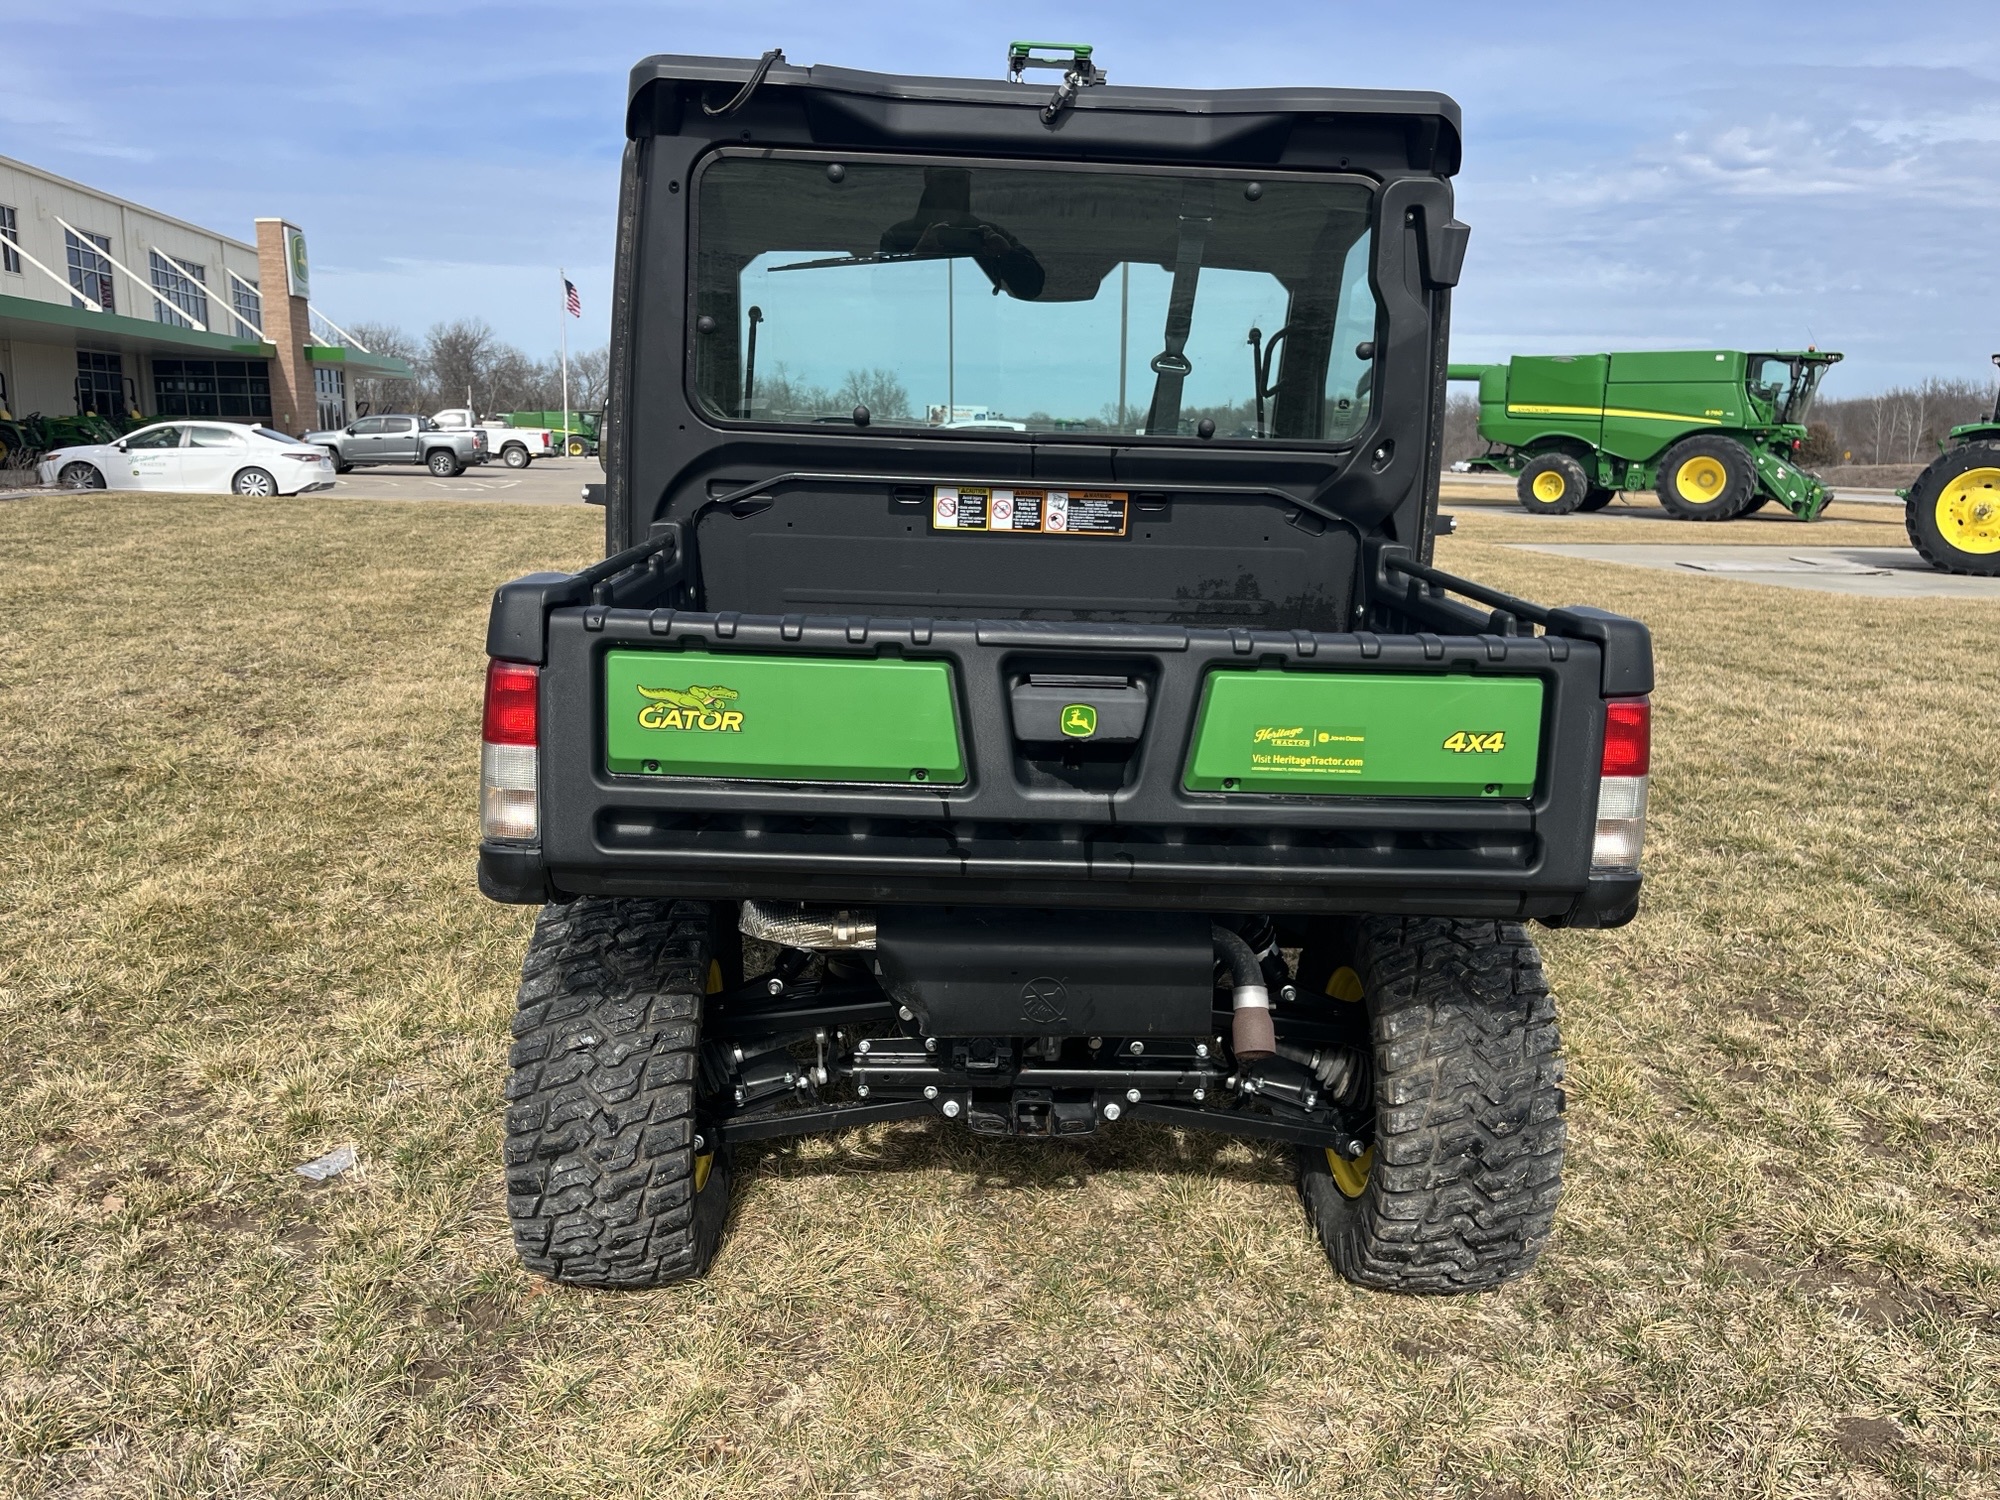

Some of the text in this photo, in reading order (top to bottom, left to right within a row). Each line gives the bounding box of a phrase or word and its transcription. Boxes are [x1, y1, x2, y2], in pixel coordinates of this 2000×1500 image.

[638, 705, 744, 732] GATOR
[1254, 728, 1304, 743] Heritage
[1271, 739, 1311, 747] TRACTOR
[1252, 754, 1364, 767] Visit HeritageTractor.com
